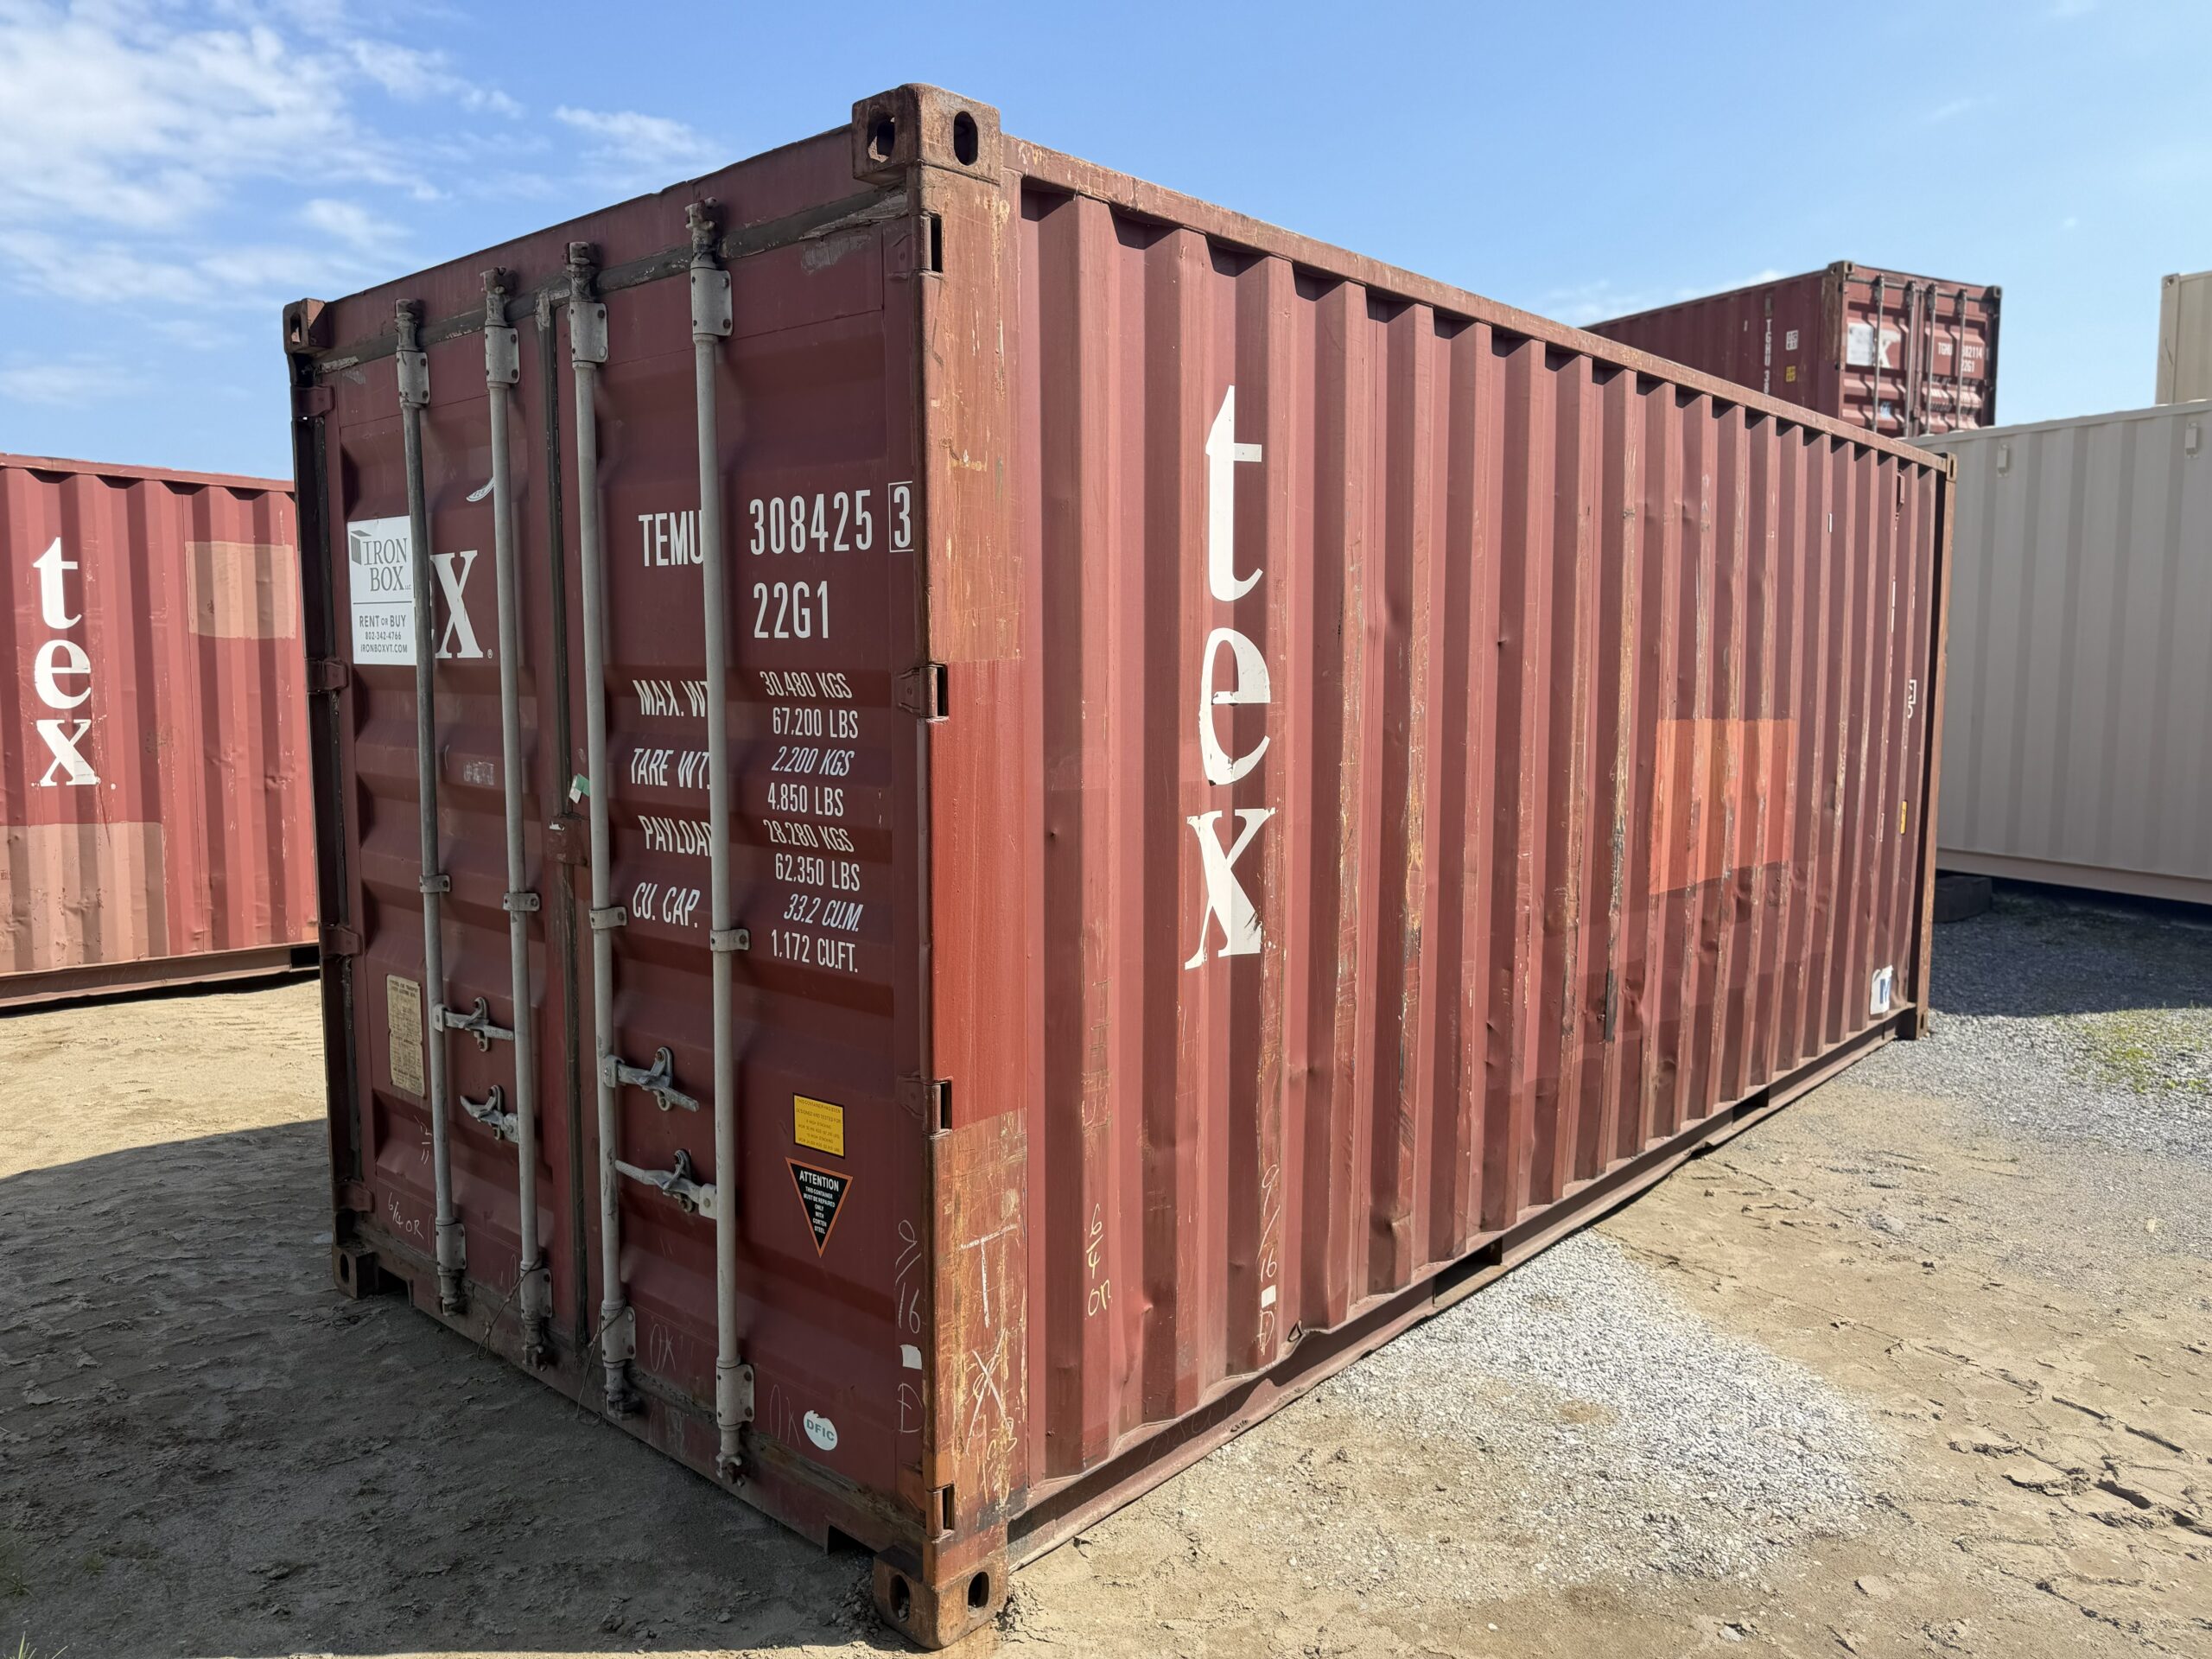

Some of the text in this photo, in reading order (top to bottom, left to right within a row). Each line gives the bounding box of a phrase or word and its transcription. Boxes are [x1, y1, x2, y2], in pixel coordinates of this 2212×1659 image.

[638, 484, 912, 567] TEMU 308425 3
[362, 537, 408, 566] IRON
[369, 565, 404, 592] BOX
[359, 614, 406, 628] RENT OR BUY
[753, 580, 830, 639] 22G1
[360, 644, 408, 653] IRONBOXVT.COM
[365, 631, 402, 640] 802-342-4766
[632, 679, 684, 717] MAX.
[760, 671, 817, 697] 30,480
[816, 671, 853, 699] KGS
[772, 707, 859, 740] 67,200 LBS
[631, 747, 674, 787] TARE
[771, 745, 819, 774] 2,200
[818, 748, 855, 777] KGS
[767, 782, 844, 817] 4,850 LBS
[817, 825, 855, 853] KGS
[775, 853, 861, 892] 62,350 LBS
[632, 881, 658, 922] CU.
[662, 886, 701, 929] CAP.
[783, 893, 822, 925] 33.2
[771, 929, 810, 963] 1,172
[798, 1170, 839, 1192] ATTENTION
[813, 1188, 833, 1199] CONTAINER
[818, 1197, 836, 1208] REPAIRED
[812, 1217, 827, 1227] CORTEN
[805, 1418, 835, 1442] DFIC
